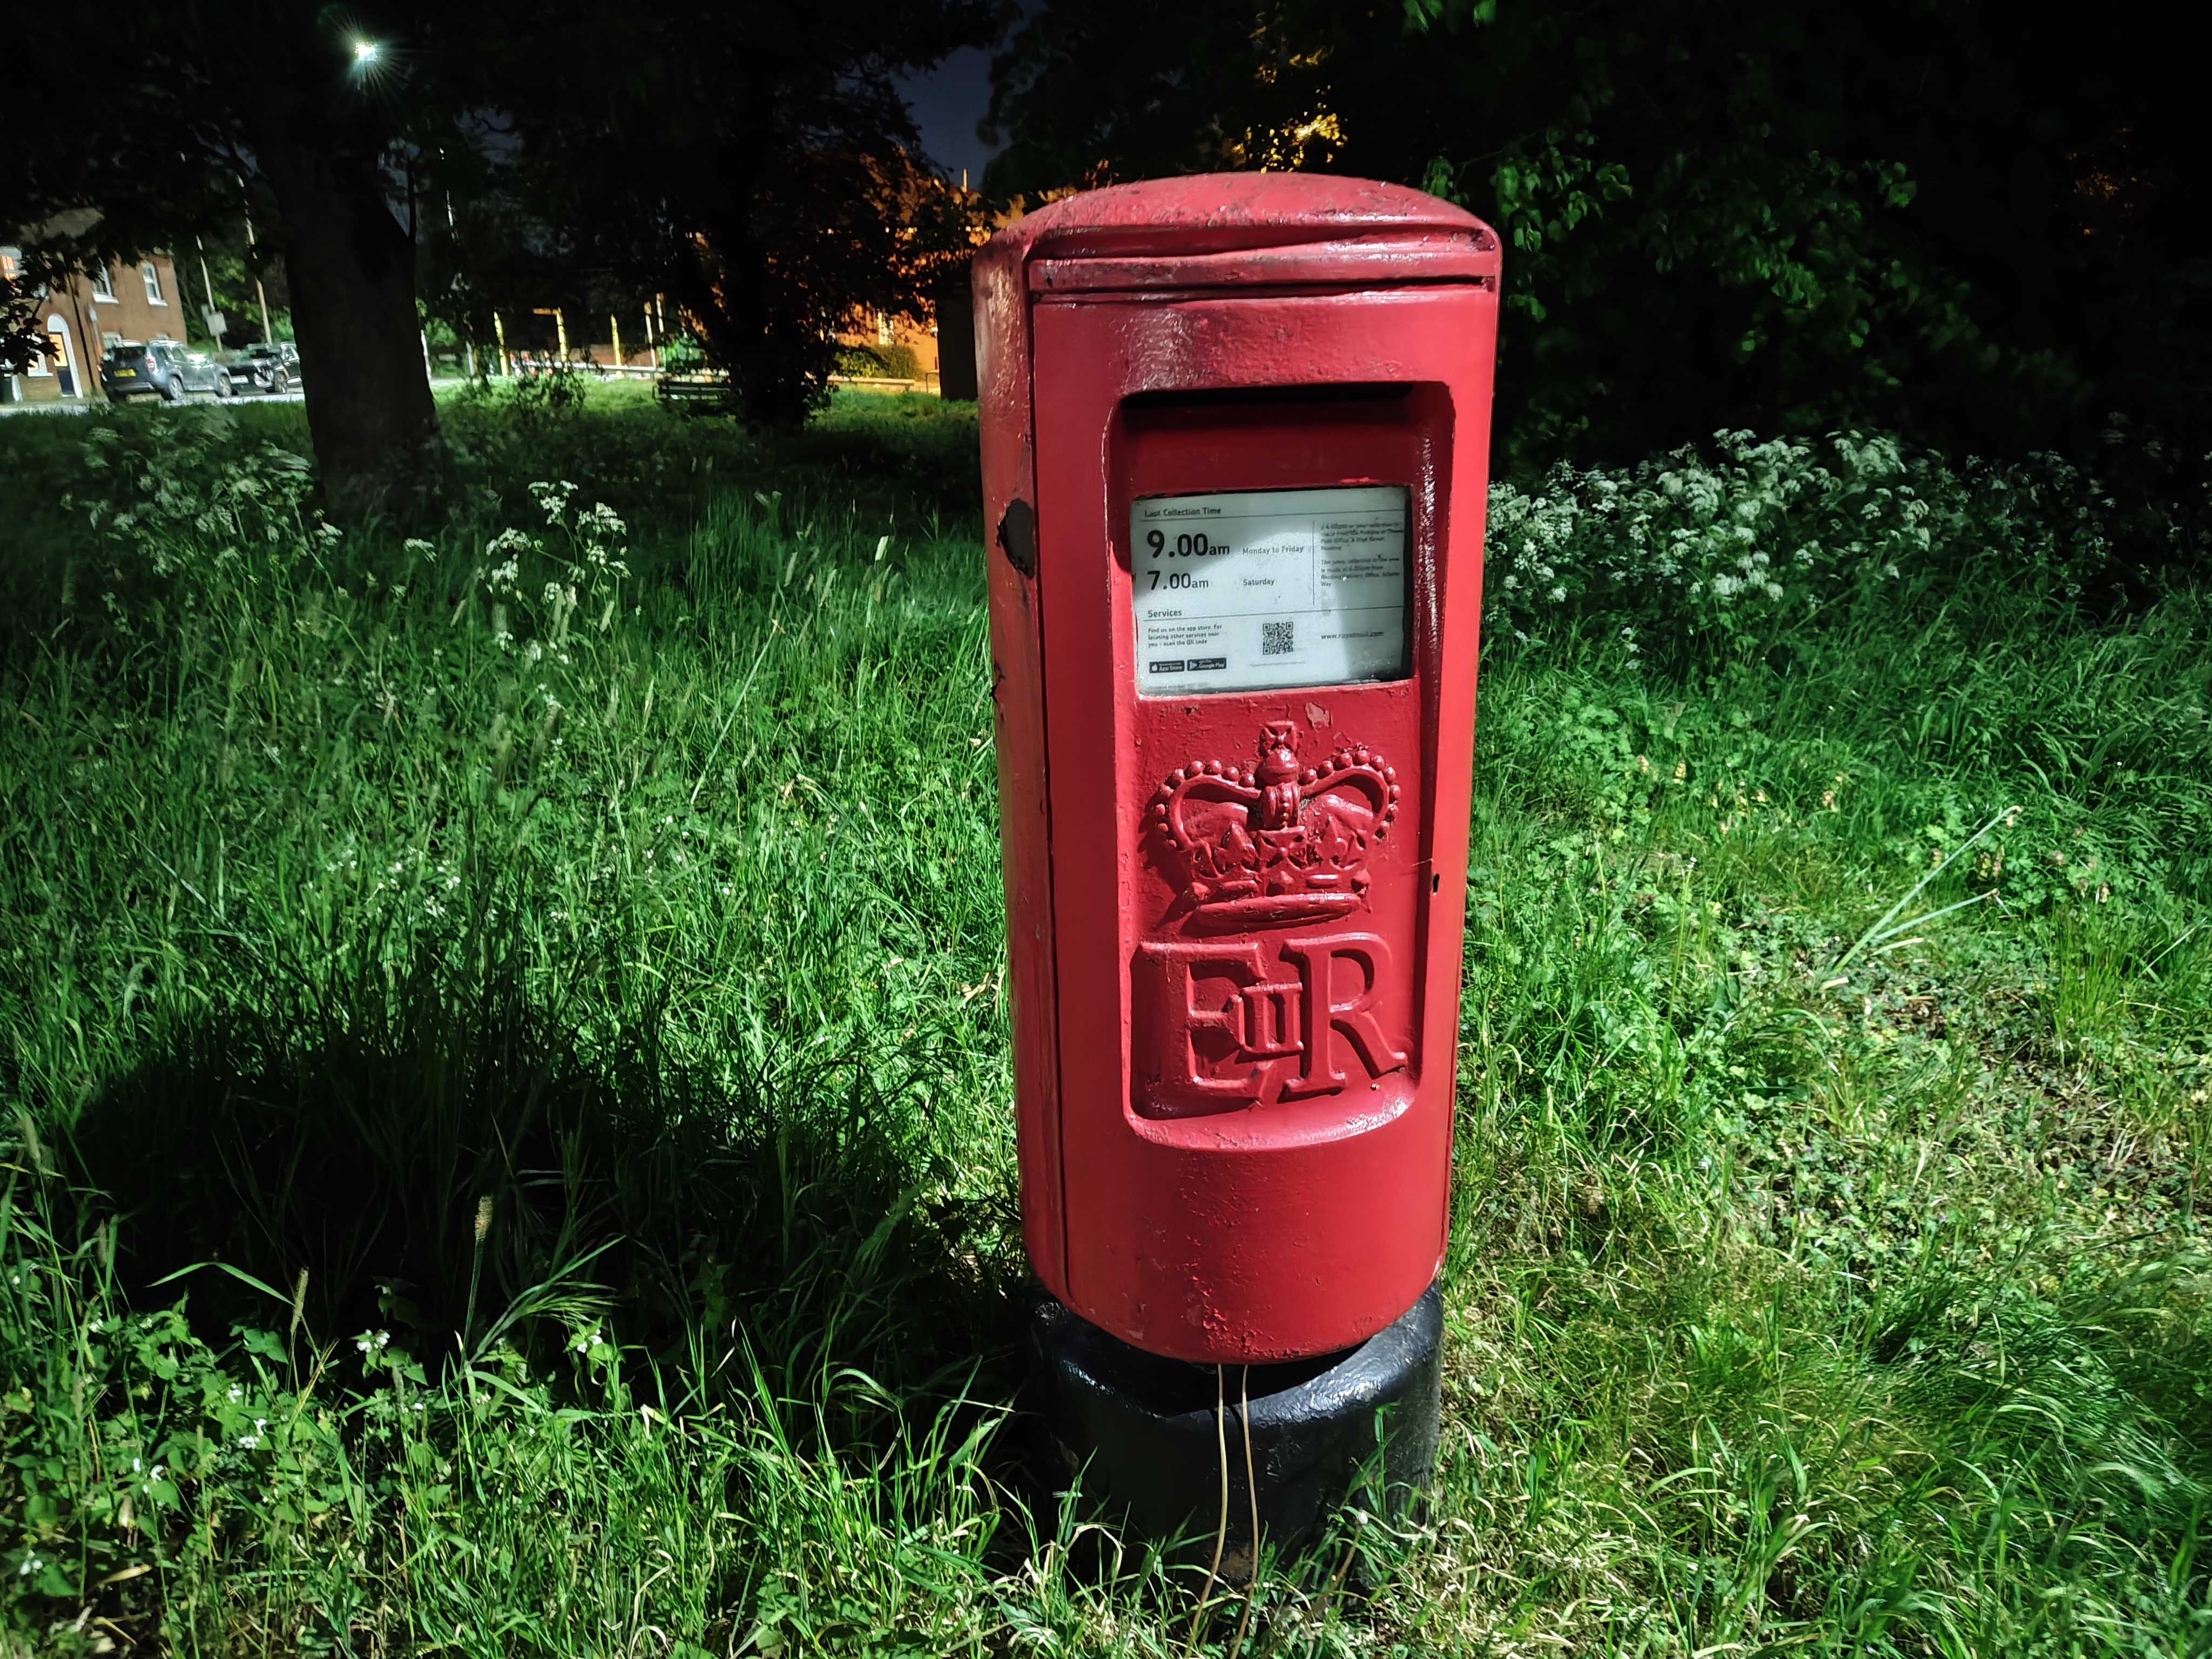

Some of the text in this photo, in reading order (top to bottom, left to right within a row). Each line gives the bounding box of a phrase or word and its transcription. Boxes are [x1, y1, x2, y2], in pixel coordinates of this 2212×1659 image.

[1163, 508, 1200, 516] Collection
[1147, 530, 1230, 558] 9.00am
[1243, 547, 1270, 555] Monday
[1282, 545, 1304, 554] Friday
[1147, 570, 1209, 590] 7.00am
[1243, 578, 1274, 586] Saturday
[1148, 609, 1182, 617] Services
